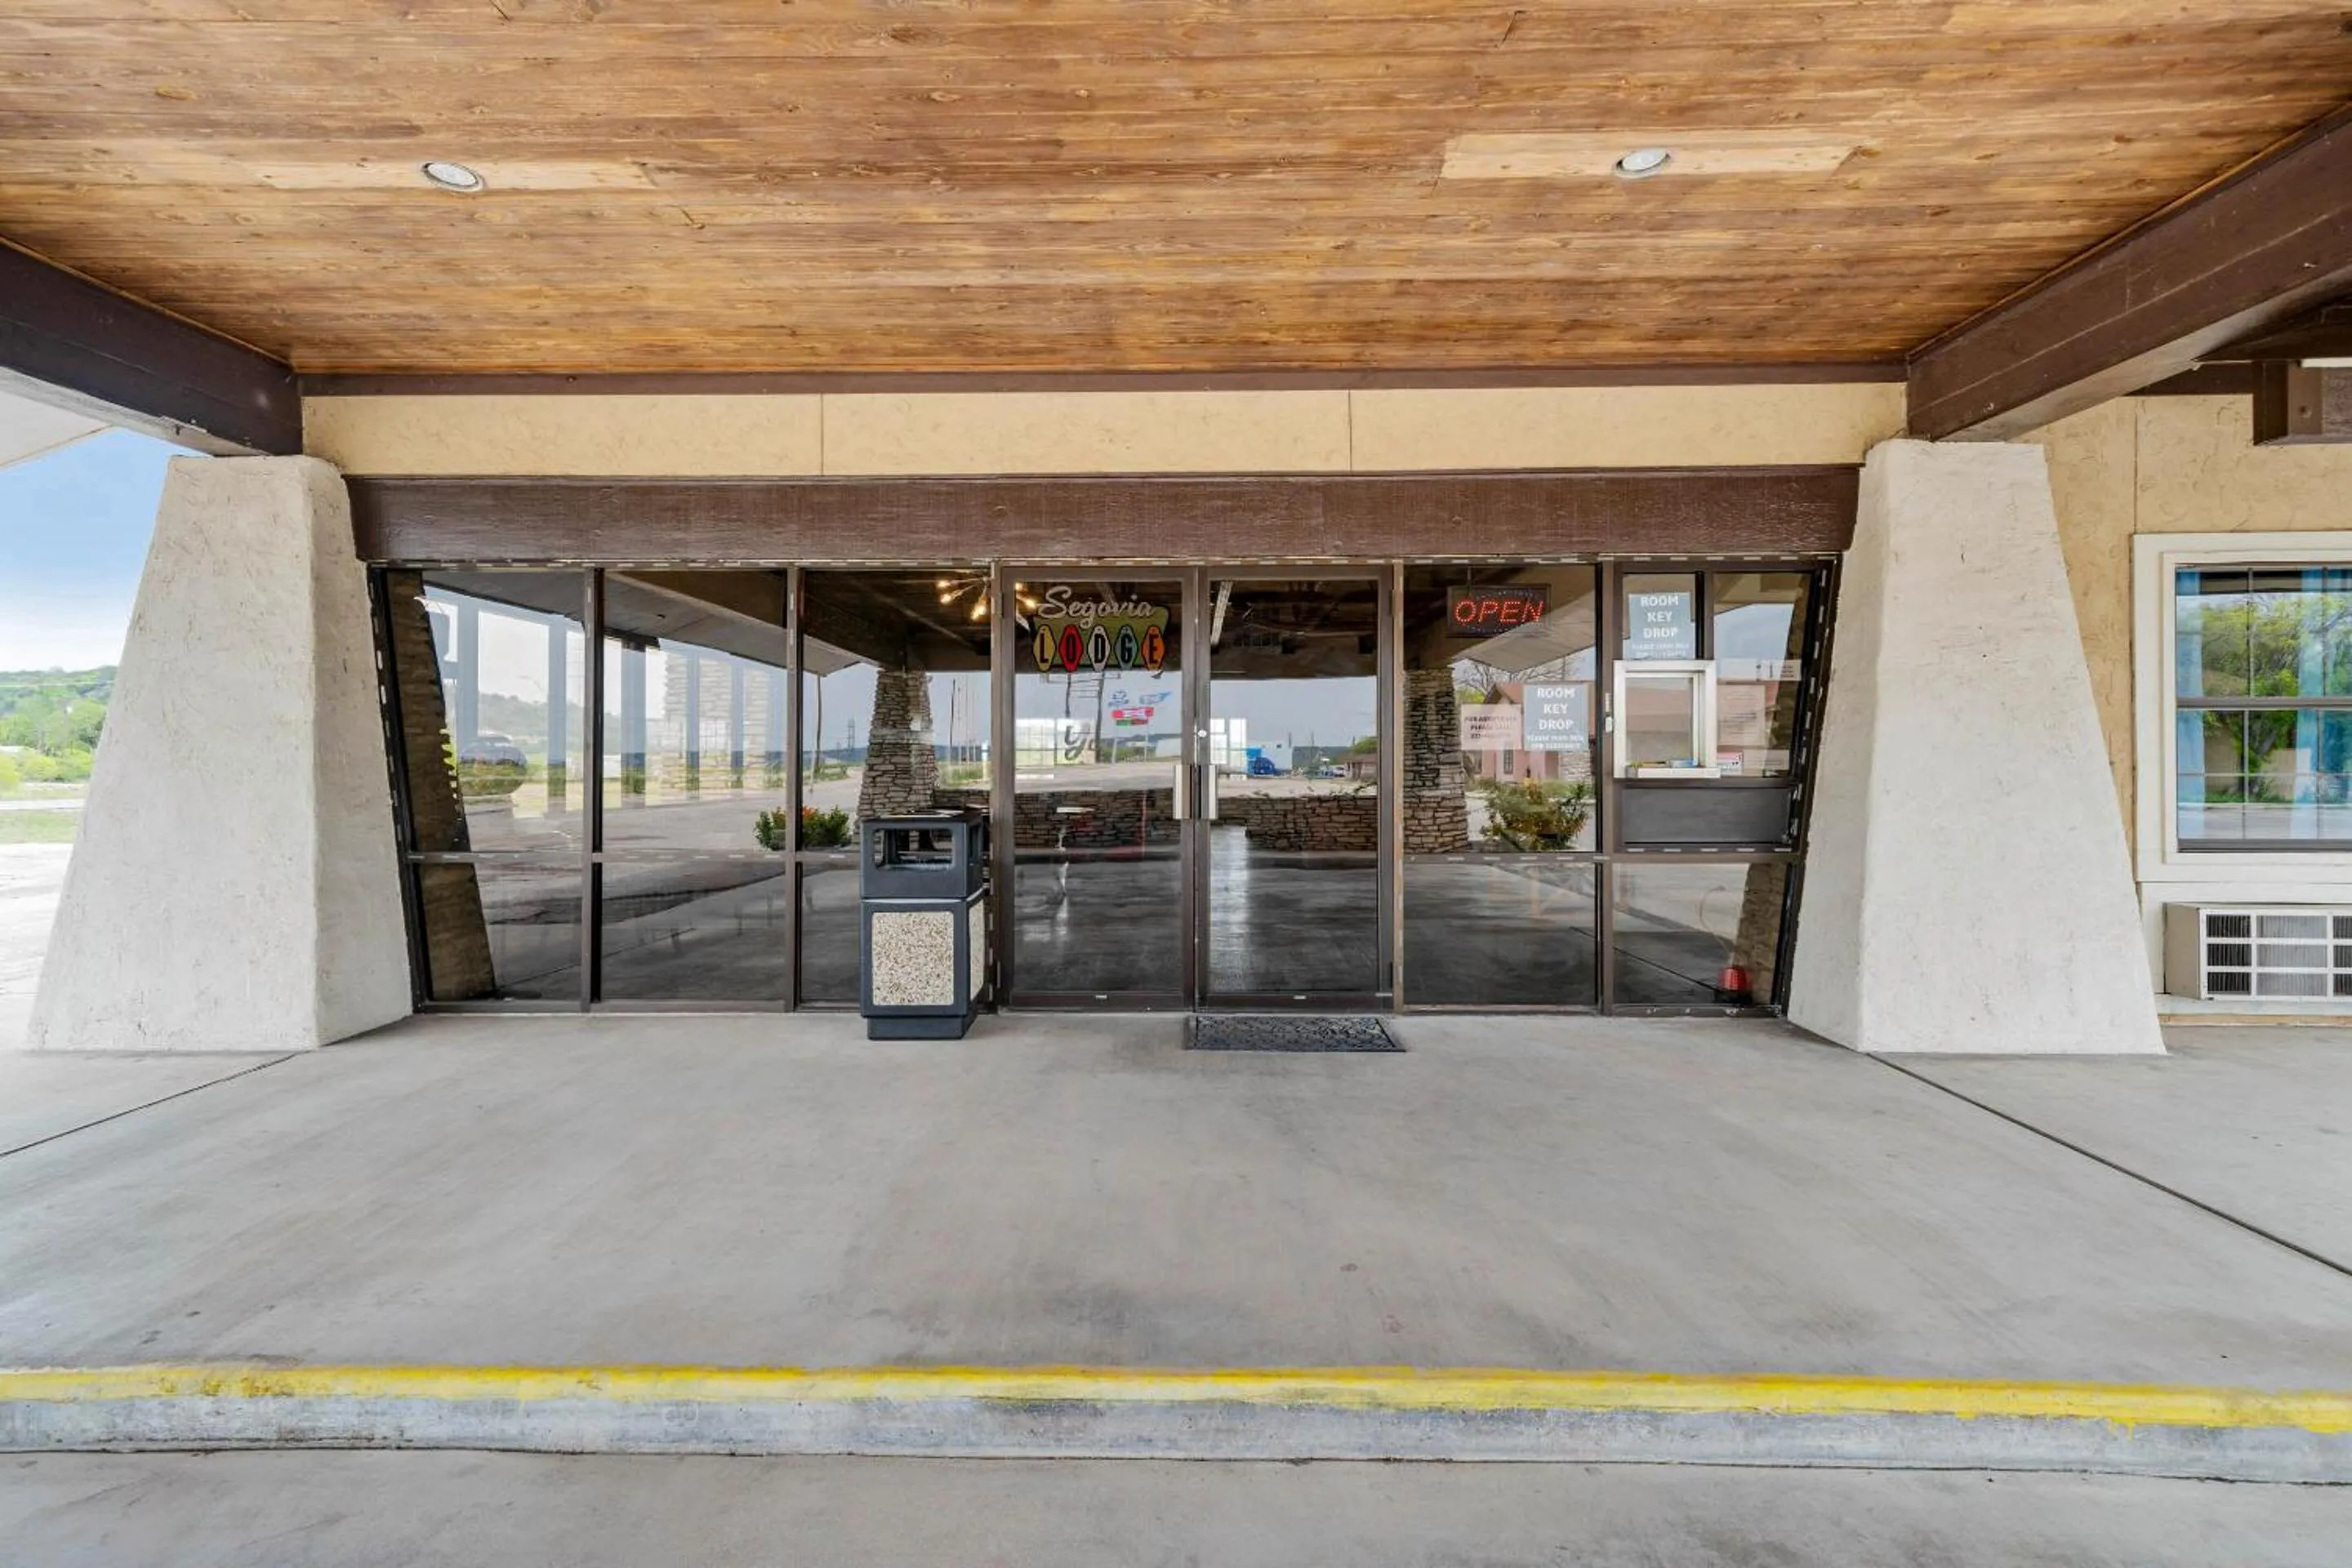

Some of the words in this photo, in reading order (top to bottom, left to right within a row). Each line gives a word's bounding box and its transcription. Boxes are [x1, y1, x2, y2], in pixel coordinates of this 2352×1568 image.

[1641, 595, 1679, 607] ROOM
[1038, 586, 1155, 629] Segovia
[1455, 600, 1544, 623] OPEN
[1647, 611, 1673, 622] KEY
[1643, 626, 1679, 639] DROP
[1039, 632, 1160, 665] LODGE
[1537, 688, 1575, 698] ROOM
[1544, 703, 1569, 715] KEY
[1539, 719, 1575, 731] DROP
